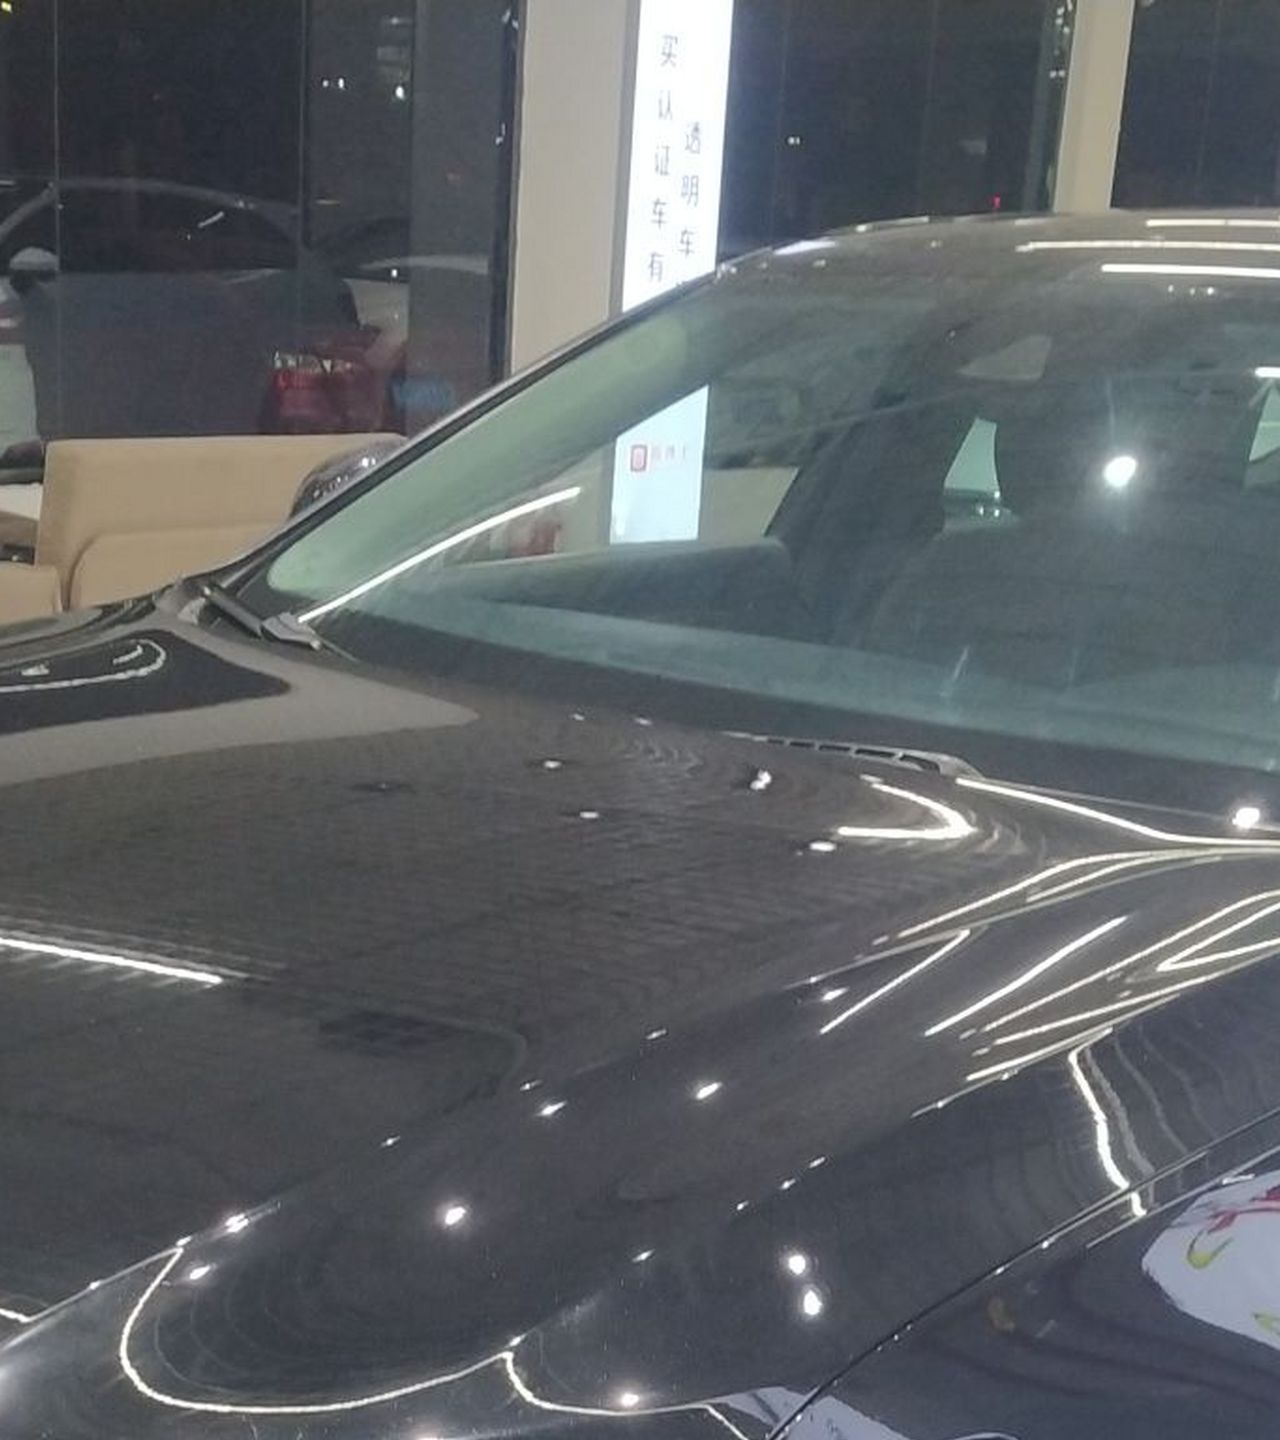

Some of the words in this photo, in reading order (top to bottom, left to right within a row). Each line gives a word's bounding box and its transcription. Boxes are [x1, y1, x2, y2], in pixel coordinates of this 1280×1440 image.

[648, 34, 678, 283] 买认证车有
[675, 120, 702, 287] 透明车
